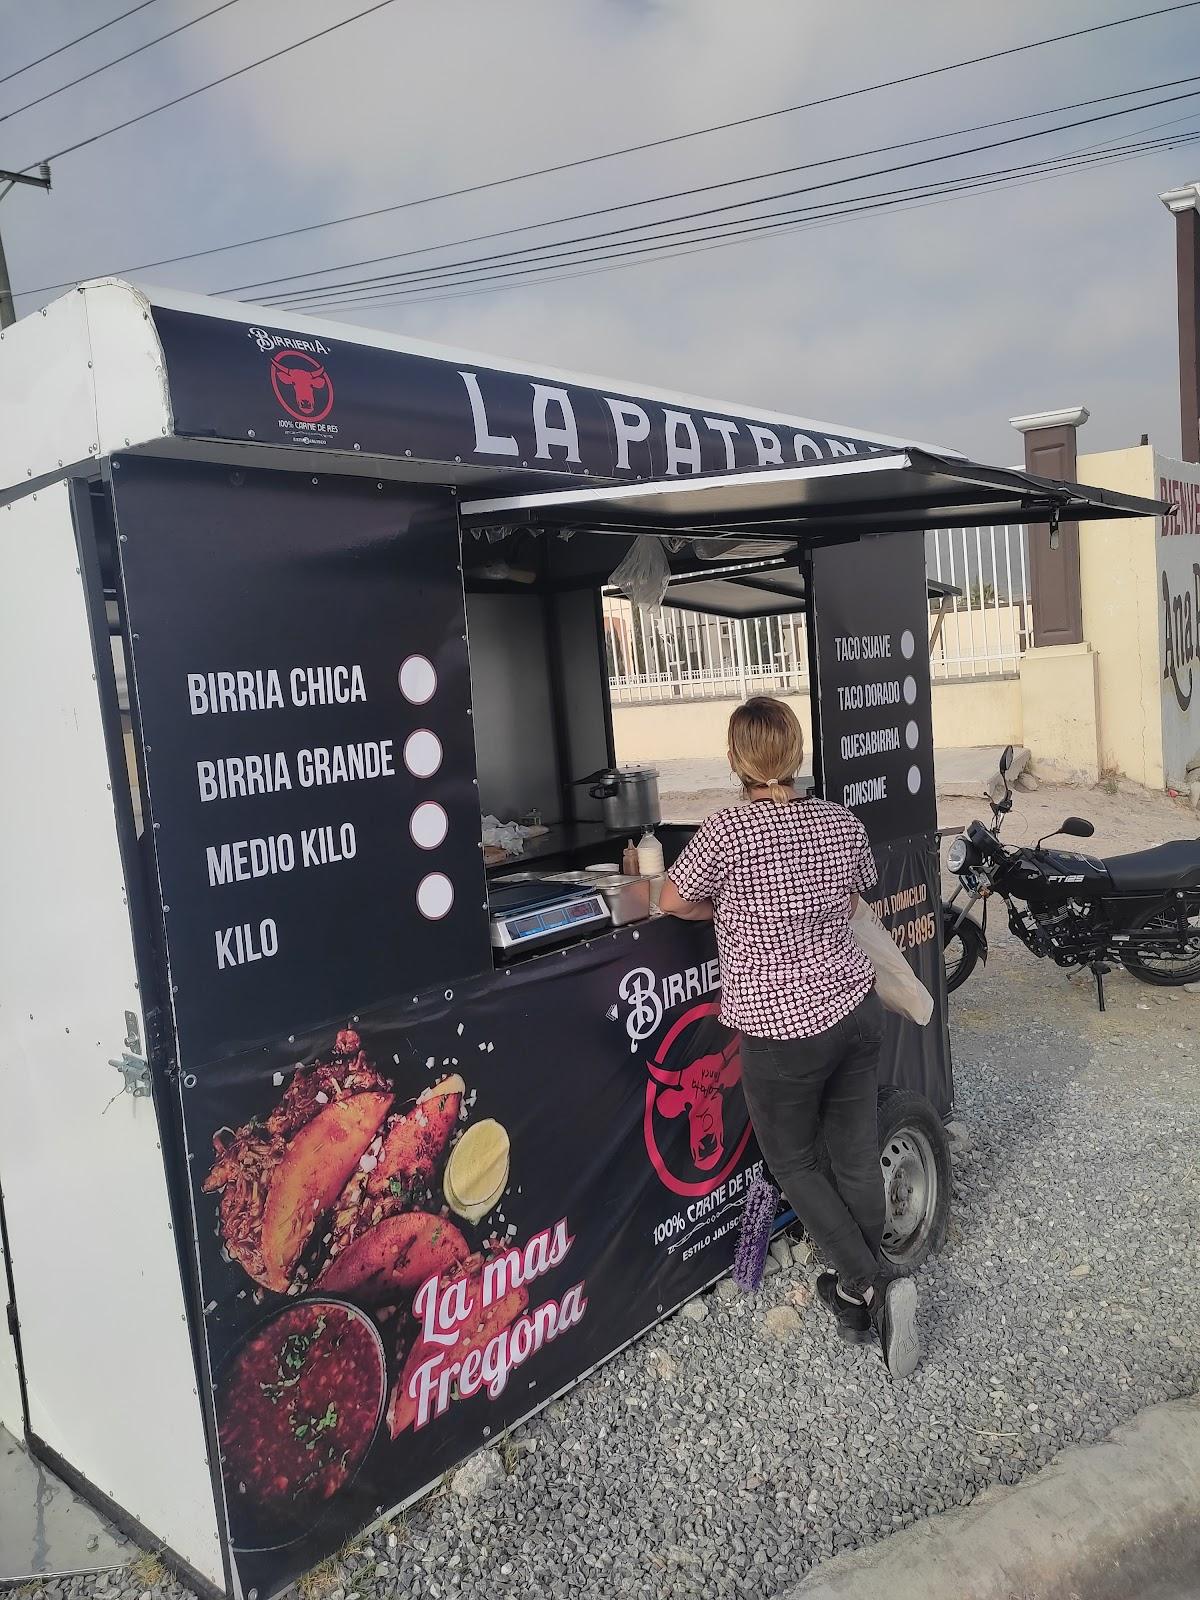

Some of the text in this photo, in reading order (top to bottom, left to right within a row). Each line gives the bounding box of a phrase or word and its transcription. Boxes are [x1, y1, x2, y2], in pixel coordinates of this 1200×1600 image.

[278, 419, 339, 434] 100% CARNE DE RES
[456, 370, 883, 476] LA PATRO
[834, 634, 892, 662] TACO SUAVE
[186, 664, 368, 715] BIRRIA CHICA
[837, 680, 900, 711] TACO DORADO
[840, 727, 901, 761] QUESABIRRIA
[196, 739, 396, 802] BIRRIA GRANDE
[843, 775, 888, 808] CONSOME
[205, 822, 357, 887] MEDIO KILO
[884, 897, 891, 917] A
[890, 883, 927, 914] DOMICILIO
[215, 918, 280, 970] KILO
[907, 912, 936, 948] 9895
[653, 1212, 686, 1246] 100%
[686, 1184, 726, 1223] CARNE
[728, 1173, 743, 1197] DE
[682, 1235, 711, 1261] ESTILO
[414, 1218, 574, 1346] La mas
[408, 1283, 588, 1428] Fregona
